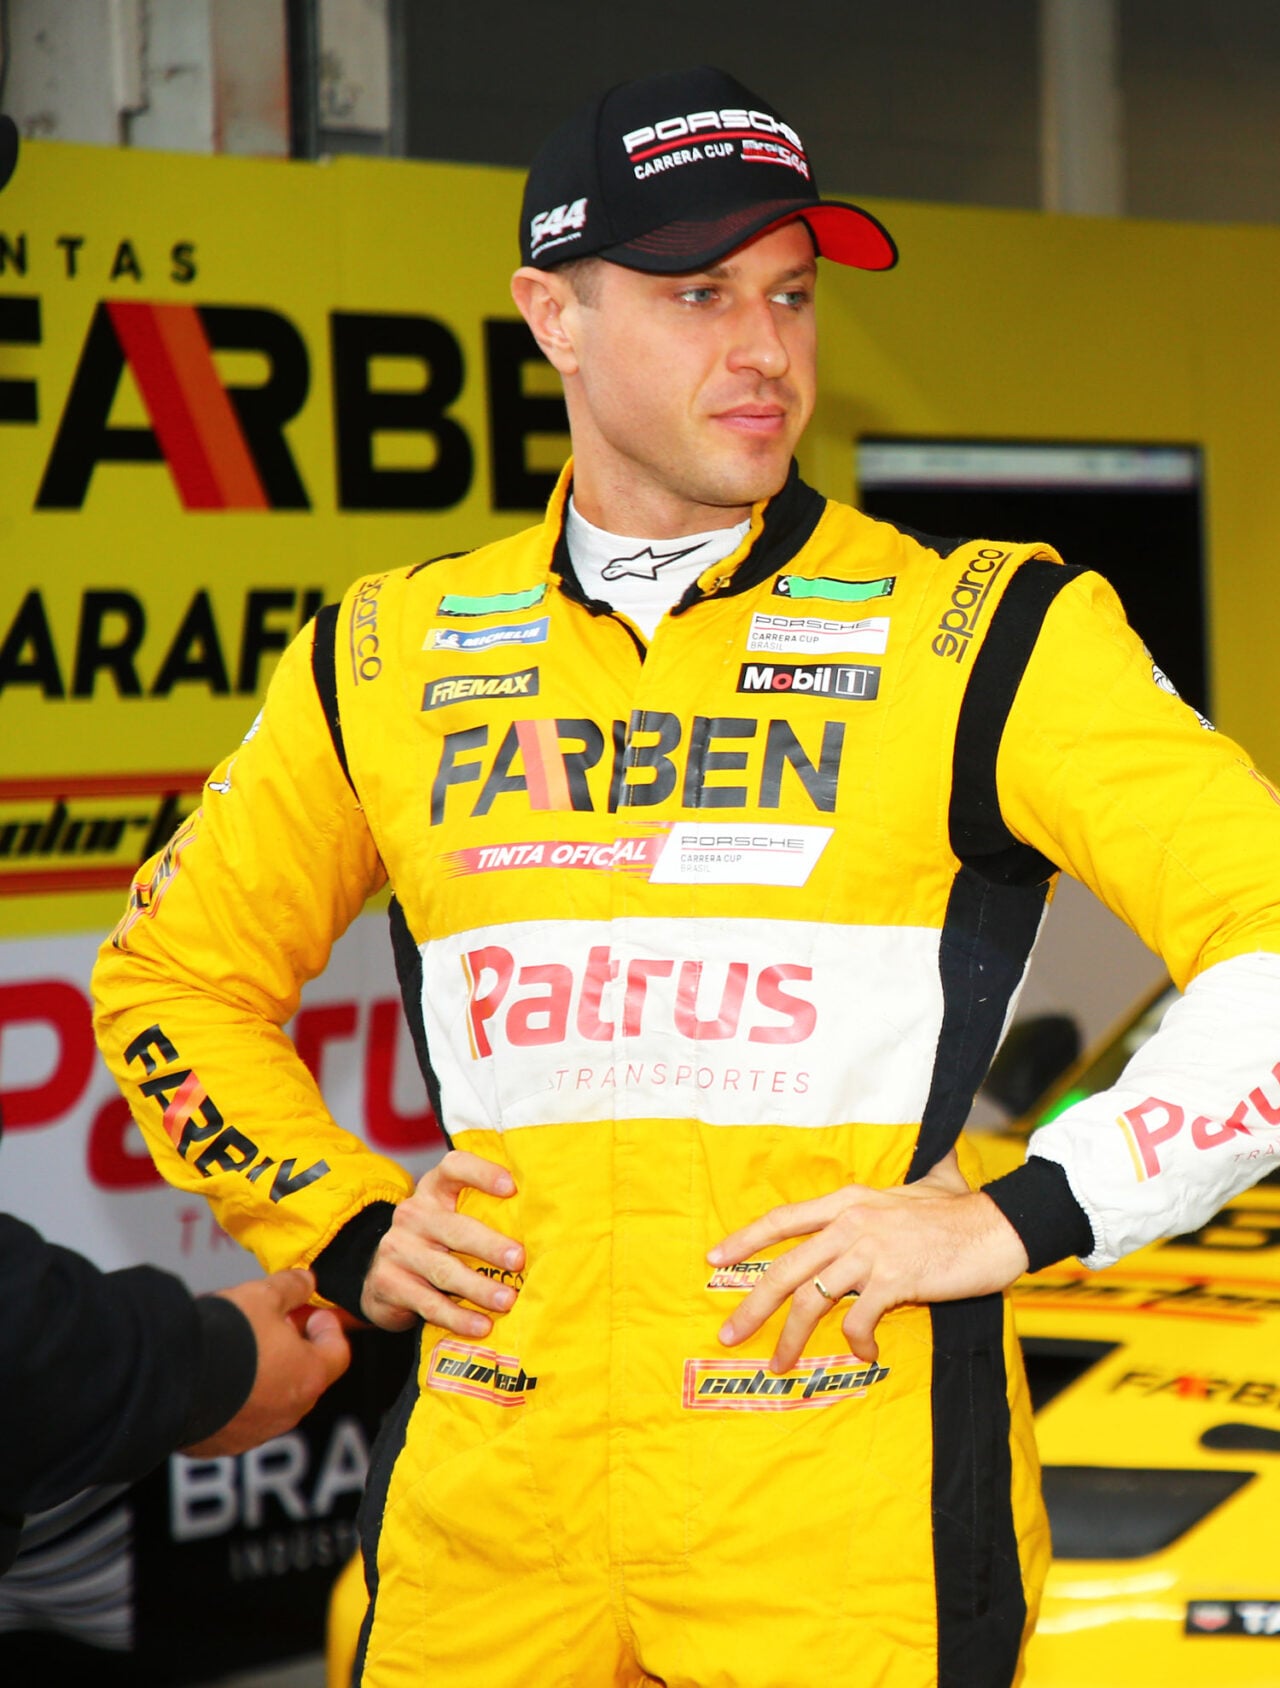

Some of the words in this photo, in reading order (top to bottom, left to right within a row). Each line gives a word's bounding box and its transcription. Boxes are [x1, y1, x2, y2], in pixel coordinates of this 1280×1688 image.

[633, 150, 704, 180] CARRERA
[705, 142, 735, 161] CUP
[530, 197, 588, 249] 544
[0, 296, 570, 513] ARBE
[931, 547, 1014, 659] sparco
[462, 626, 540, 647] MICHELIN
[751, 632, 797, 643] CARRERA
[798, 634, 820, 645] CUP
[755, 615, 873, 631] PORSCHE
[0, 583, 325, 702] ARAF
[431, 673, 533, 706] FREMAX
[743, 666, 832, 693] Mobil
[430, 710, 846, 826] FARBEN
[478, 846, 548, 867] TINTA
[680, 854, 722, 863] CARRERA
[723, 854, 742, 863] CUP
[681, 836, 804, 849] PORSCHE
[461, 945, 818, 1060] Patrus
[554, 1063, 811, 1094] TRANSPORTES
[698, 1360, 889, 1399] colortech
[168, 1419, 370, 1543] BRA
